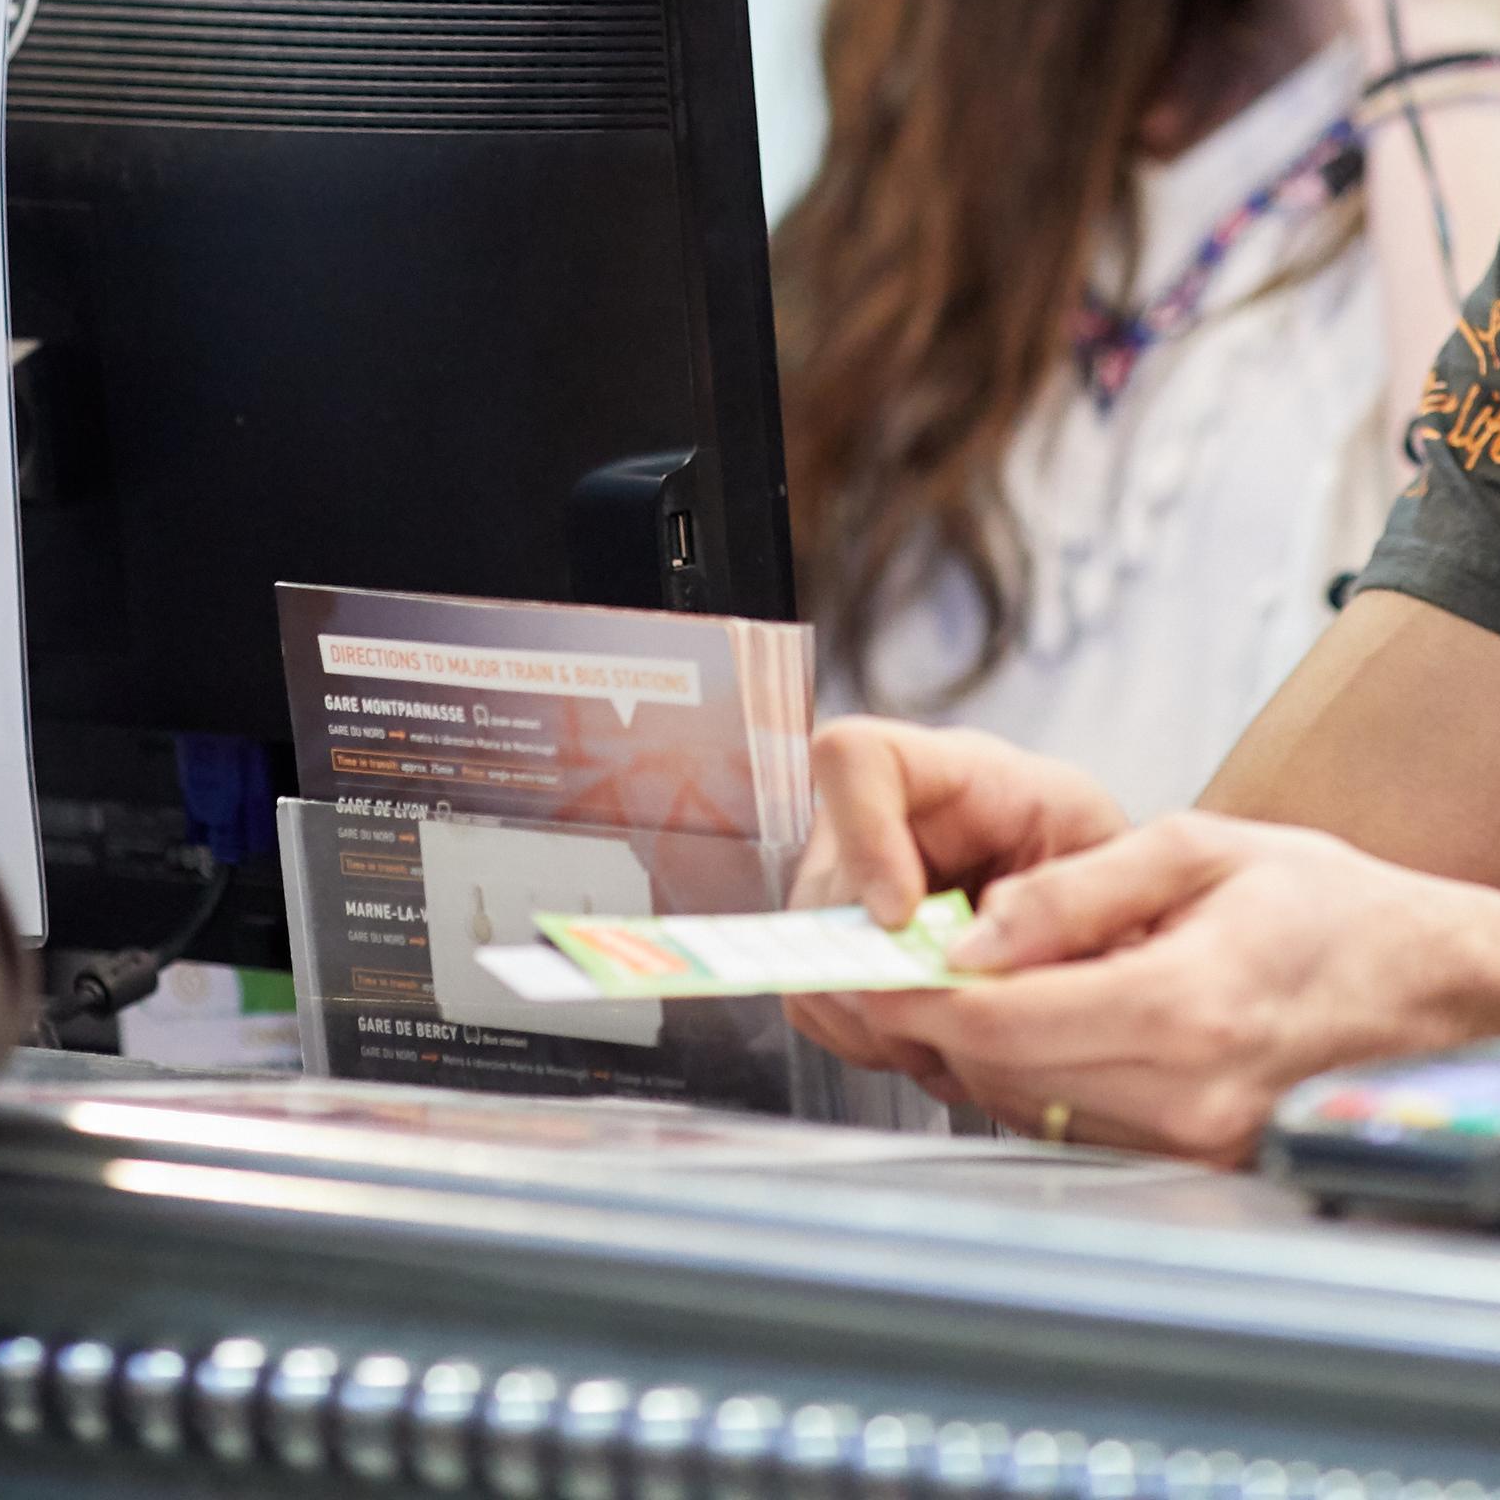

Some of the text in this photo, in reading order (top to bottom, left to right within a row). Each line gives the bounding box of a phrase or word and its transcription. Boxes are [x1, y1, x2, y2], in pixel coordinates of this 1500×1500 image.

[330, 644, 420, 671] DIRECTIONS
[425, 653, 443, 673] TO
[449, 657, 500, 678] MAJOR
[505, 660, 554, 682] TRAIN
[574, 665, 608, 687] BUS
[324, 694, 359, 713] GARE
[362, 698, 466, 723] MONTPARNASSE
[328, 724, 349, 736] GARE
[350, 725, 362, 738] DU
[363, 727, 386, 740] NORD
[336, 797, 371, 817] GARE
[373, 799, 392, 818] DE
[394, 802, 429, 820] LYON
[346, 901, 428, 923] MARNE-LA-V
[358, 1016, 392, 1034] GARE
[395, 1020, 412, 1036] DE
[416, 1022, 458, 1041] BERCY
